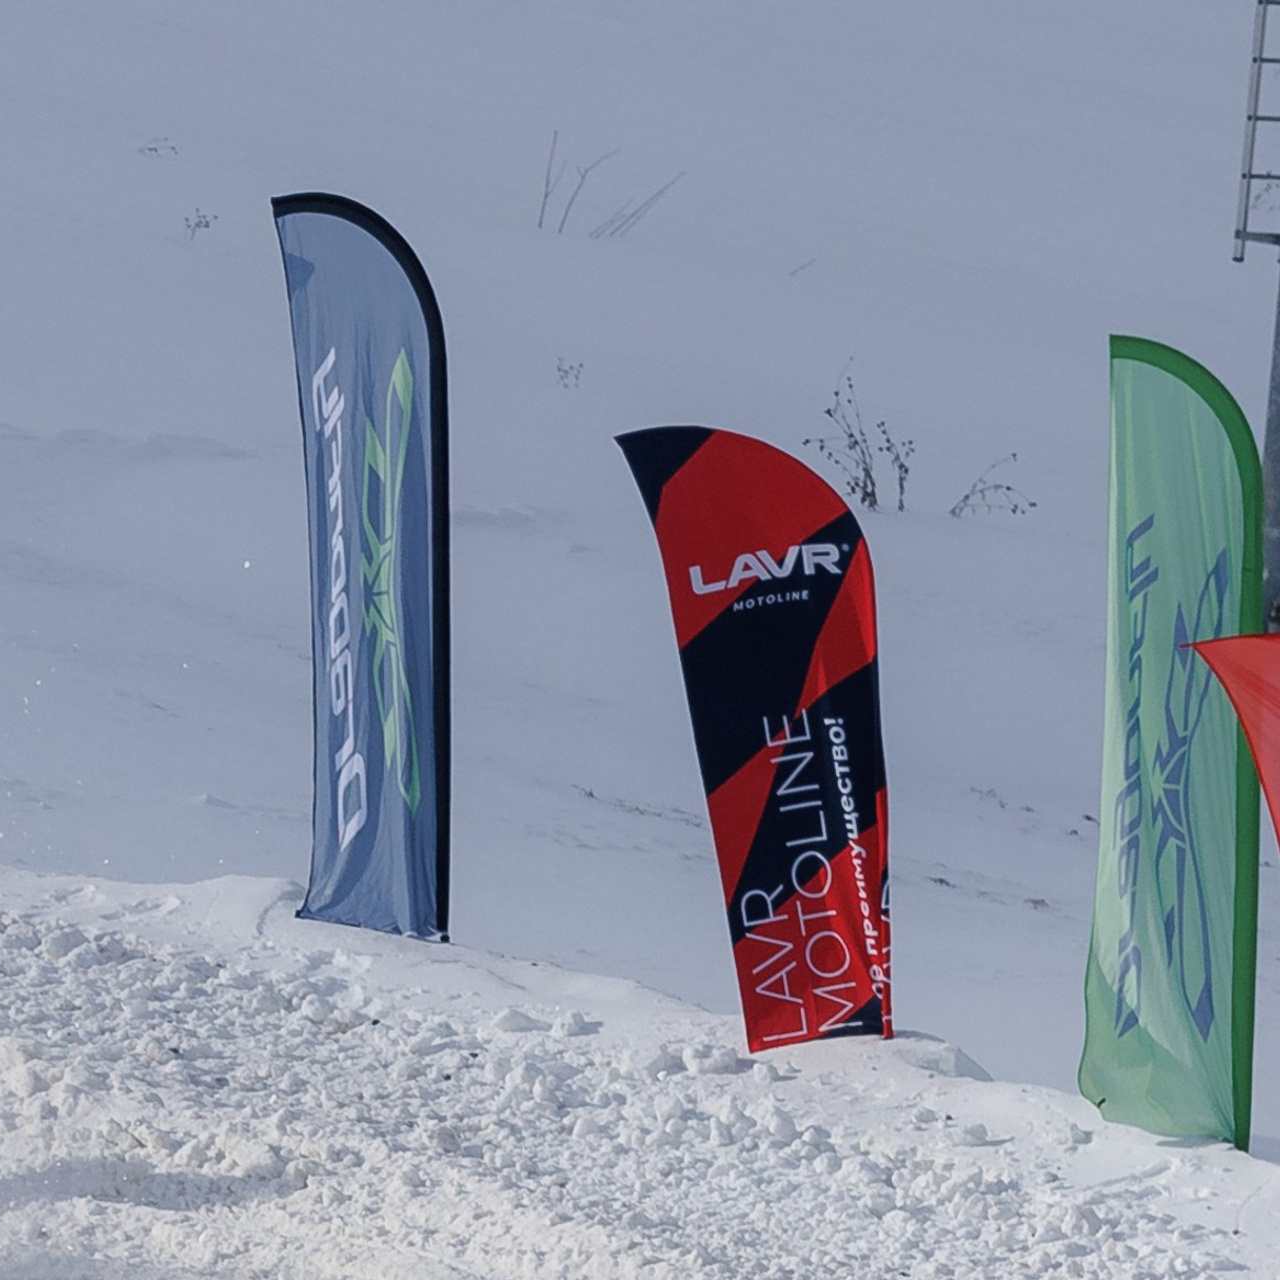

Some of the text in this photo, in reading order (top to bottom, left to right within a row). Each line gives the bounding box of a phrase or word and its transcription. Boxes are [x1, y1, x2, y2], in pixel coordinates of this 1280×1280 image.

[689, 543, 843, 595] LAVR
[733, 590, 810, 612] MOTOLINE
[763, 708, 863, 1032] MOTOLINE
[824, 717, 878, 956] преимущество!
[741, 884, 808, 1042] LAVR
